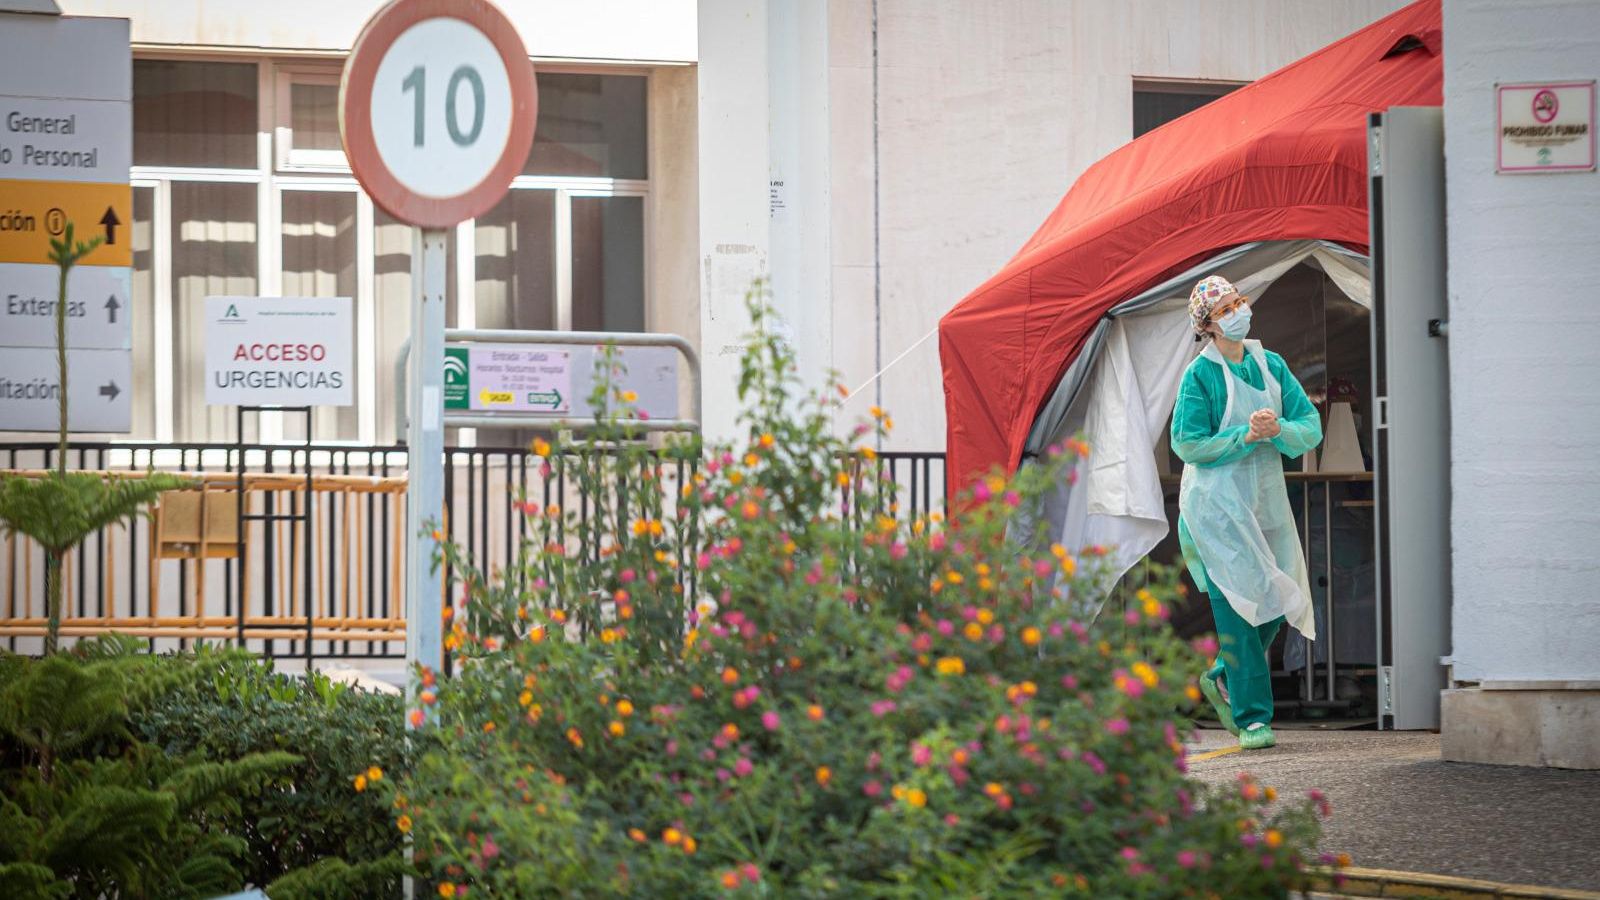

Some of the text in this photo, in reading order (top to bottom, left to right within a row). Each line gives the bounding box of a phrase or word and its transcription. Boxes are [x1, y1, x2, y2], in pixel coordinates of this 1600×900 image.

[402, 64, 486, 148] 10
[7, 111, 76, 135] General
[1502, 124, 1588, 137] PROHIBIDO FUMAR
[23, 145, 98, 168] Personal
[7, 294, 87, 318] Exteras
[234, 344, 326, 362] ACCESO
[215, 371, 343, 389] URGENCIAS
